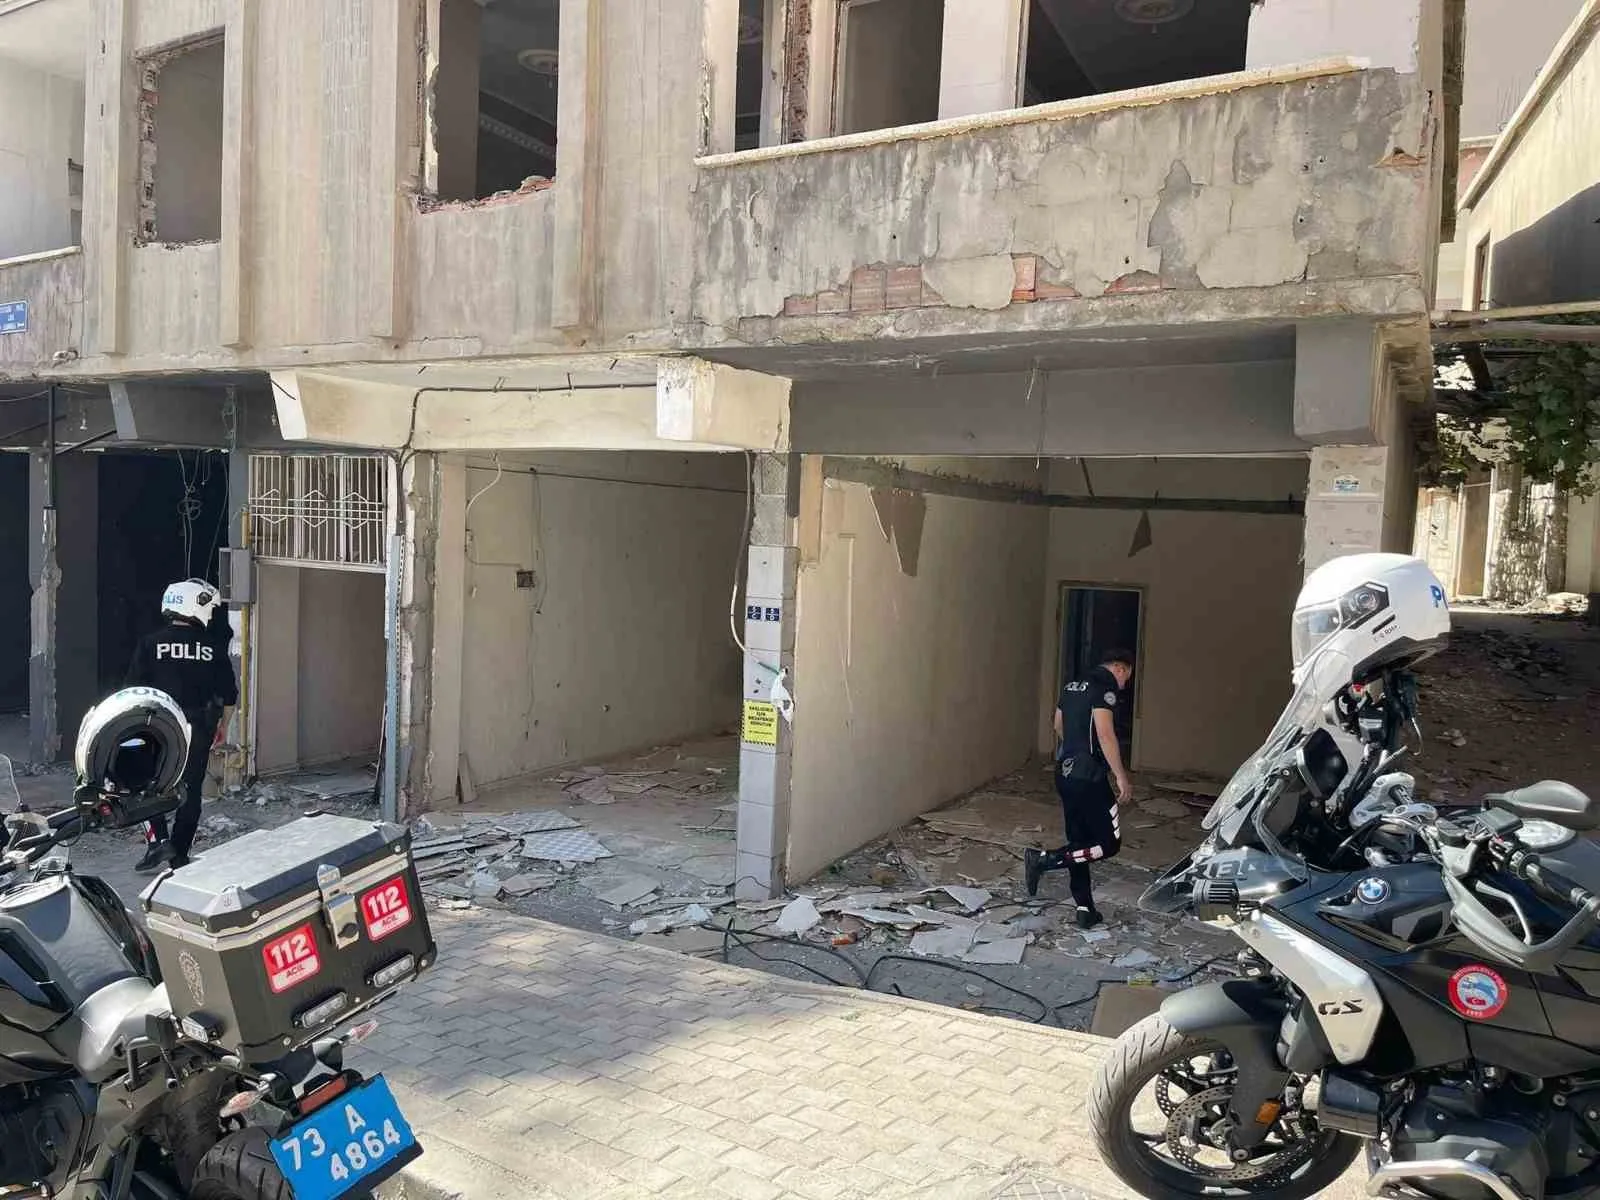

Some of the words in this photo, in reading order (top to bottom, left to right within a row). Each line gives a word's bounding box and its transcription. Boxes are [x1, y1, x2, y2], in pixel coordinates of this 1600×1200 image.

[157, 642, 213, 661] POLİS
[367, 885, 400, 919] 112
[270, 933, 310, 969] 112
[1318, 999, 1363, 1015] GS
[281, 1127, 326, 1171] 73
[344, 1103, 366, 1134] A
[330, 1117, 401, 1181] 4864
